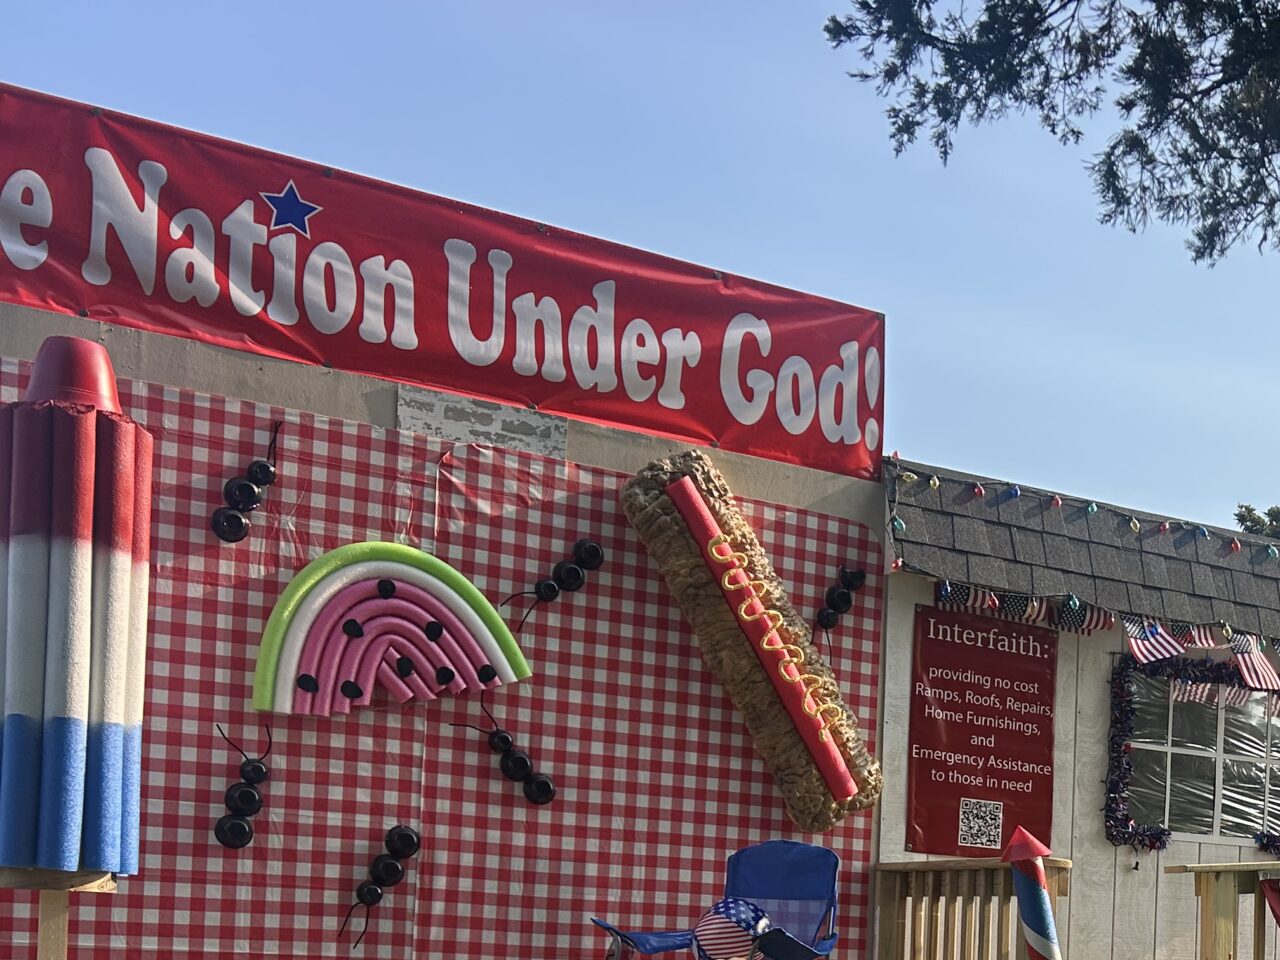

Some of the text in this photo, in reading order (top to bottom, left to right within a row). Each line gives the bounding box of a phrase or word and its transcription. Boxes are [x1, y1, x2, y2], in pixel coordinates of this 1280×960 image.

[81, 146, 419, 351] Nation
[443, 237, 702, 411] Under
[718, 312, 881, 453] God!
[926, 617, 1050, 659] Interfaith:
[928, 666, 1039, 694] providing no cost
[915, 682, 1054, 720] Ramps, Roofs, Repairs,
[924, 704, 1041, 736] Home Furnishings,
[970, 732, 995, 748] and
[912, 744, 1052, 776] Emergency Assistance
[931, 769, 1033, 793] to those in need
